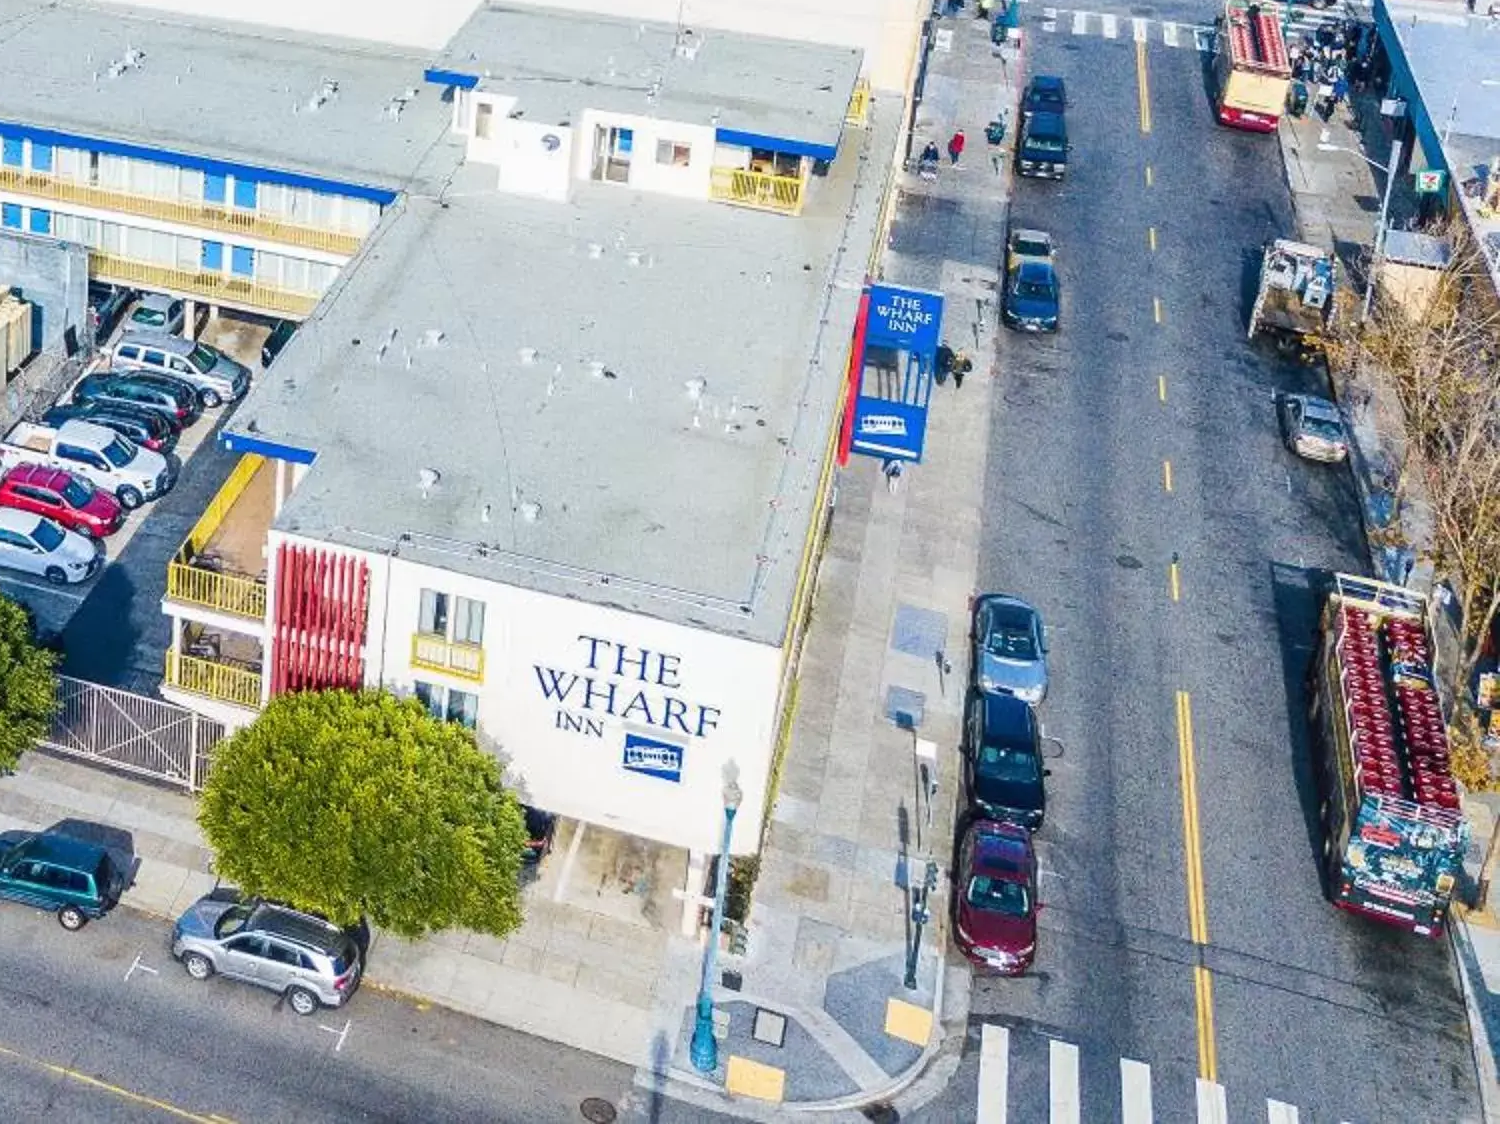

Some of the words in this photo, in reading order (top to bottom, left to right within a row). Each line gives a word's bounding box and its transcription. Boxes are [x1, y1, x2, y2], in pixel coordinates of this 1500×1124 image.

[877, 305, 933, 325] WHARF
[891, 295, 921, 311] THE
[888, 319, 917, 333] INN
[577, 634, 682, 689] THE
[532, 664, 722, 739] WHARF
[555, 710, 605, 739] INN
